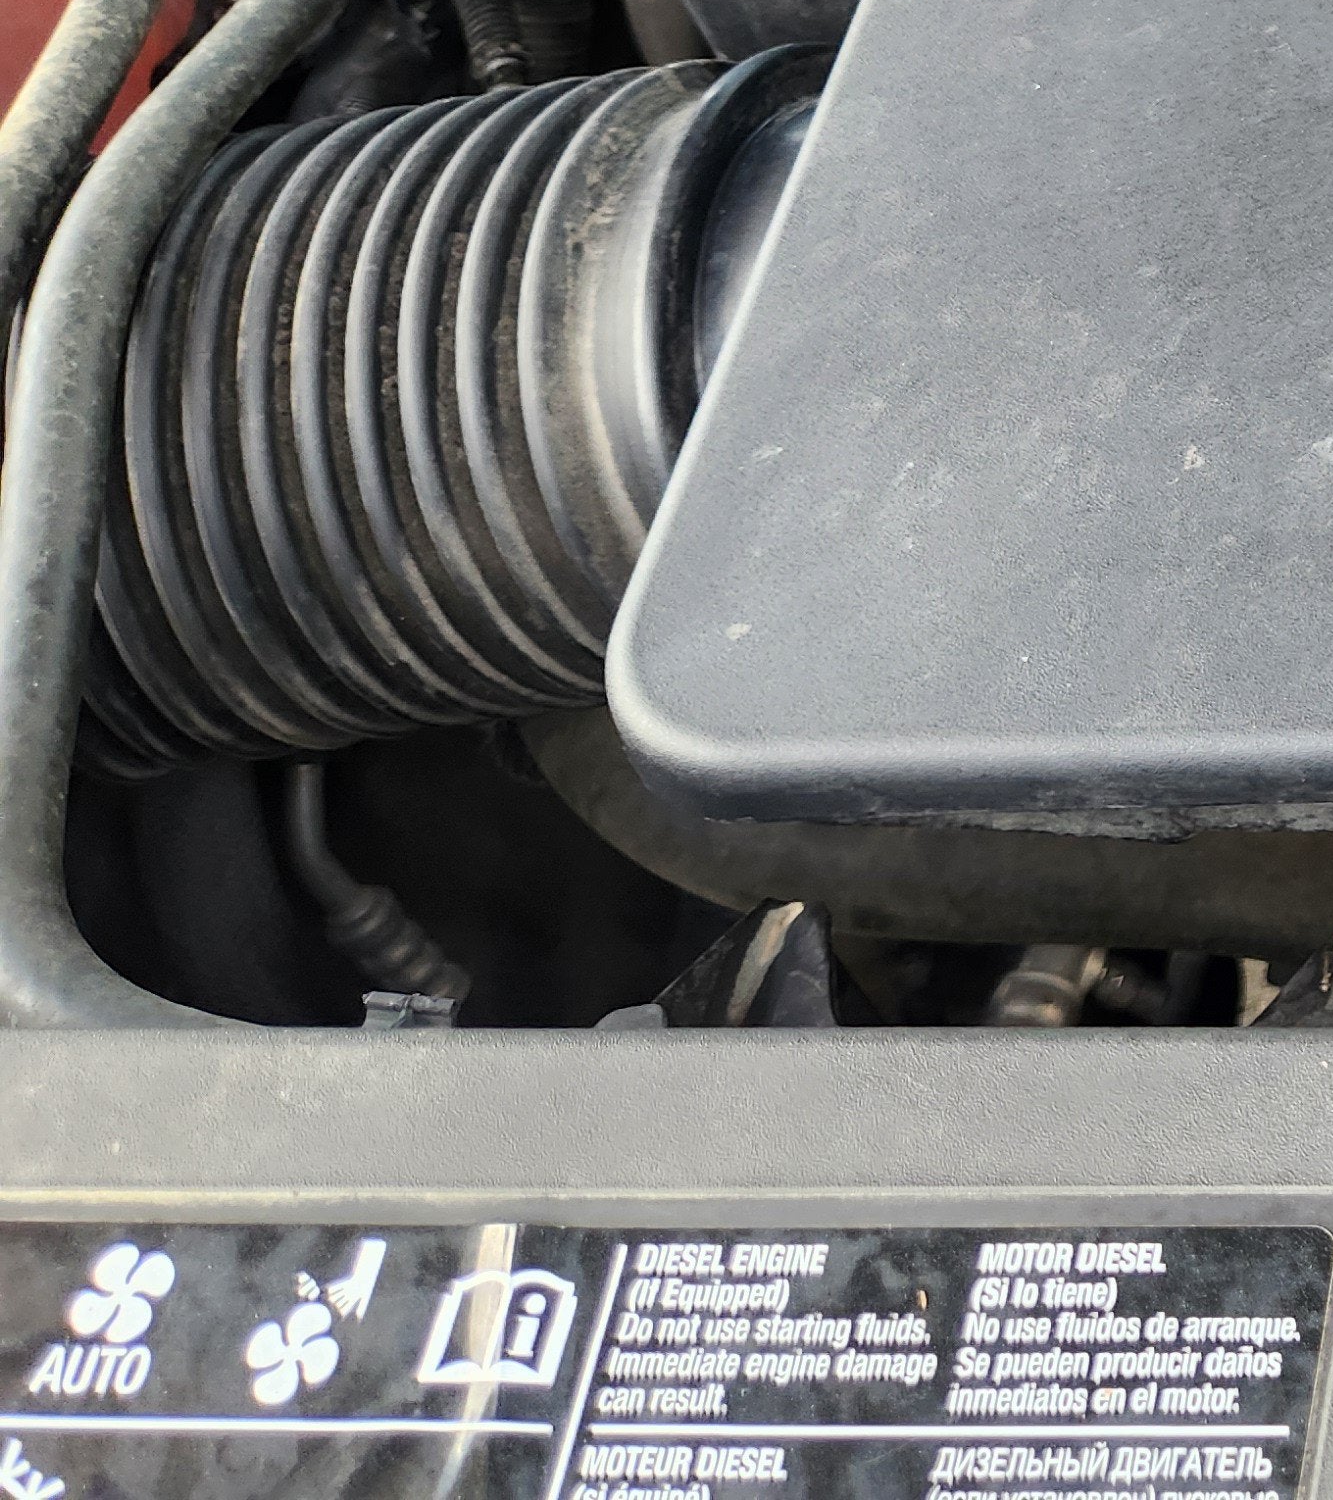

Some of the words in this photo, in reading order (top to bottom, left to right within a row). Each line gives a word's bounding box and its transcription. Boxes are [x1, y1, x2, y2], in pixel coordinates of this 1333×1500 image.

[636, 1243, 725, 1275] DIESEL
[731, 1243, 829, 1275] ENGINE
[977, 1243, 1073, 1274] MOTOR
[1075, 1242, 1166, 1273] DIESEL
[628, 1278, 664, 1312] (If
[663, 1279, 790, 1316] Equipped)
[970, 1277, 1009, 1312] (Si
[1013, 1277, 1040, 1309] lo
[1044, 1276, 1118, 1313] tiene)
[617, 1313, 653, 1344] Do
[657, 1315, 701, 1344] not
[704, 1319, 750, 1344] use
[754, 1314, 852, 1349] starting
[854, 1313, 931, 1346] fluids.
[962, 1312, 1000, 1344] No
[1003, 1317, 1051, 1343] use
[1144, 1311, 1178, 1343] de
[1181, 1316, 1301, 1347] arranque.
[28, 1343, 152, 1397] AUTO
[607, 1348, 741, 1381] Immediate
[744, 1349, 831, 1386] engine
[833, 1349, 938, 1386] damage
[953, 1347, 990, 1380] Se
[992, 1348, 1090, 1384] pueden
[1091, 1346, 1202, 1384] producir
[1204, 1345, 1283, 1378] daños
[597, 1387, 645, 1418] can
[649, 1384, 728, 1418] result.
[945, 1382, 1088, 1417] inmediatos
[1091, 1387, 1127, 1414] en
[1129, 1383, 1158, 1414] el
[1159, 1385, 1240, 1414] motor.
[579, 1446, 694, 1481] MOTEUR
[695, 1447, 788, 1482] DIESEL
[928, 1441, 1109, 1486] ДИЗЕЛЬНЫЙ
[1108, 1446, 1273, 1486] ДВИГАТЕЛЬ
